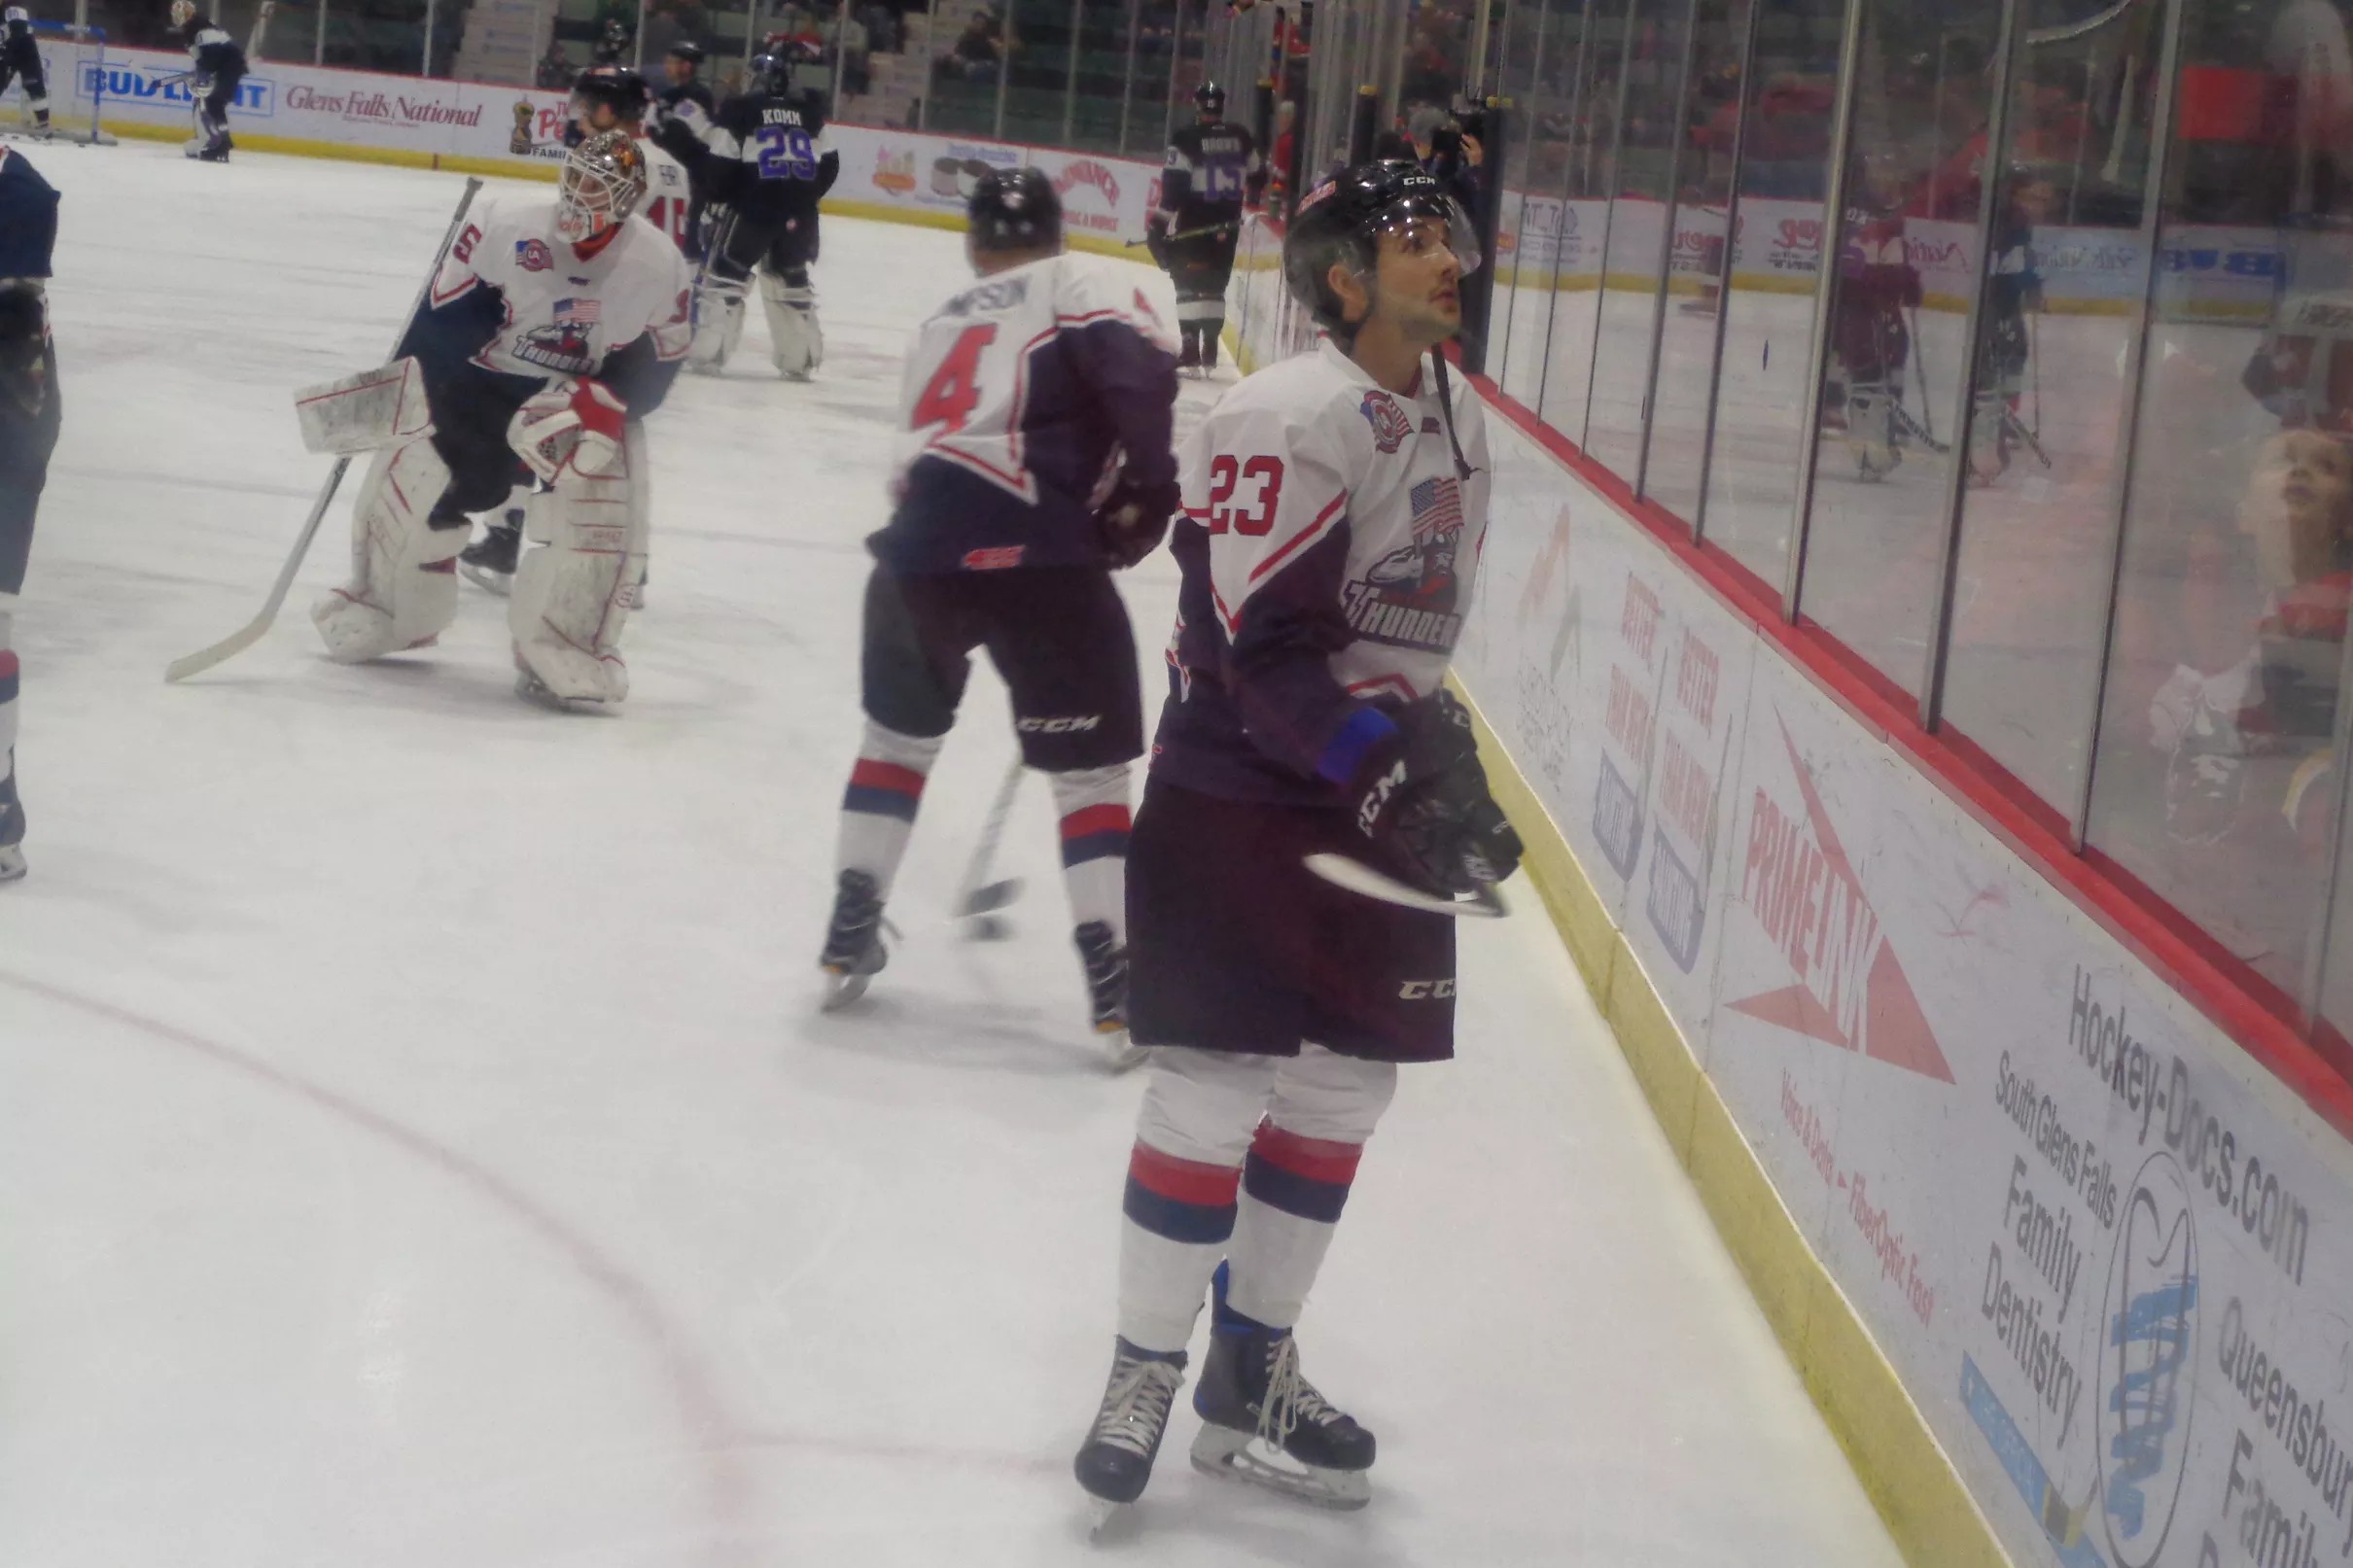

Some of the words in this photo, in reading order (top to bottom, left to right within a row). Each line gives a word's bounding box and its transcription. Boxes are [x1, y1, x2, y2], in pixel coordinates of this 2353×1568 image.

[286, 85, 343, 115] Glens
[344, 90, 390, 118] Falls
[390, 95, 482, 127] National
[755, 125, 818, 182] 29
[910, 323, 998, 435] 4
[1210, 454, 1284, 536] 23
[1019, 714, 1102, 733] CCM
[1398, 979, 1456, 999] CC
[1995, 1050, 2036, 1139] South
[2036, 1095, 2080, 1187] Glens
[2077, 1139, 2118, 1231] Falls
[2068, 962, 2309, 1286] Hockey-Docs.com
[2003, 1154, 2082, 1324] Family
[1981, 1240, 2083, 1449] Dentistry
